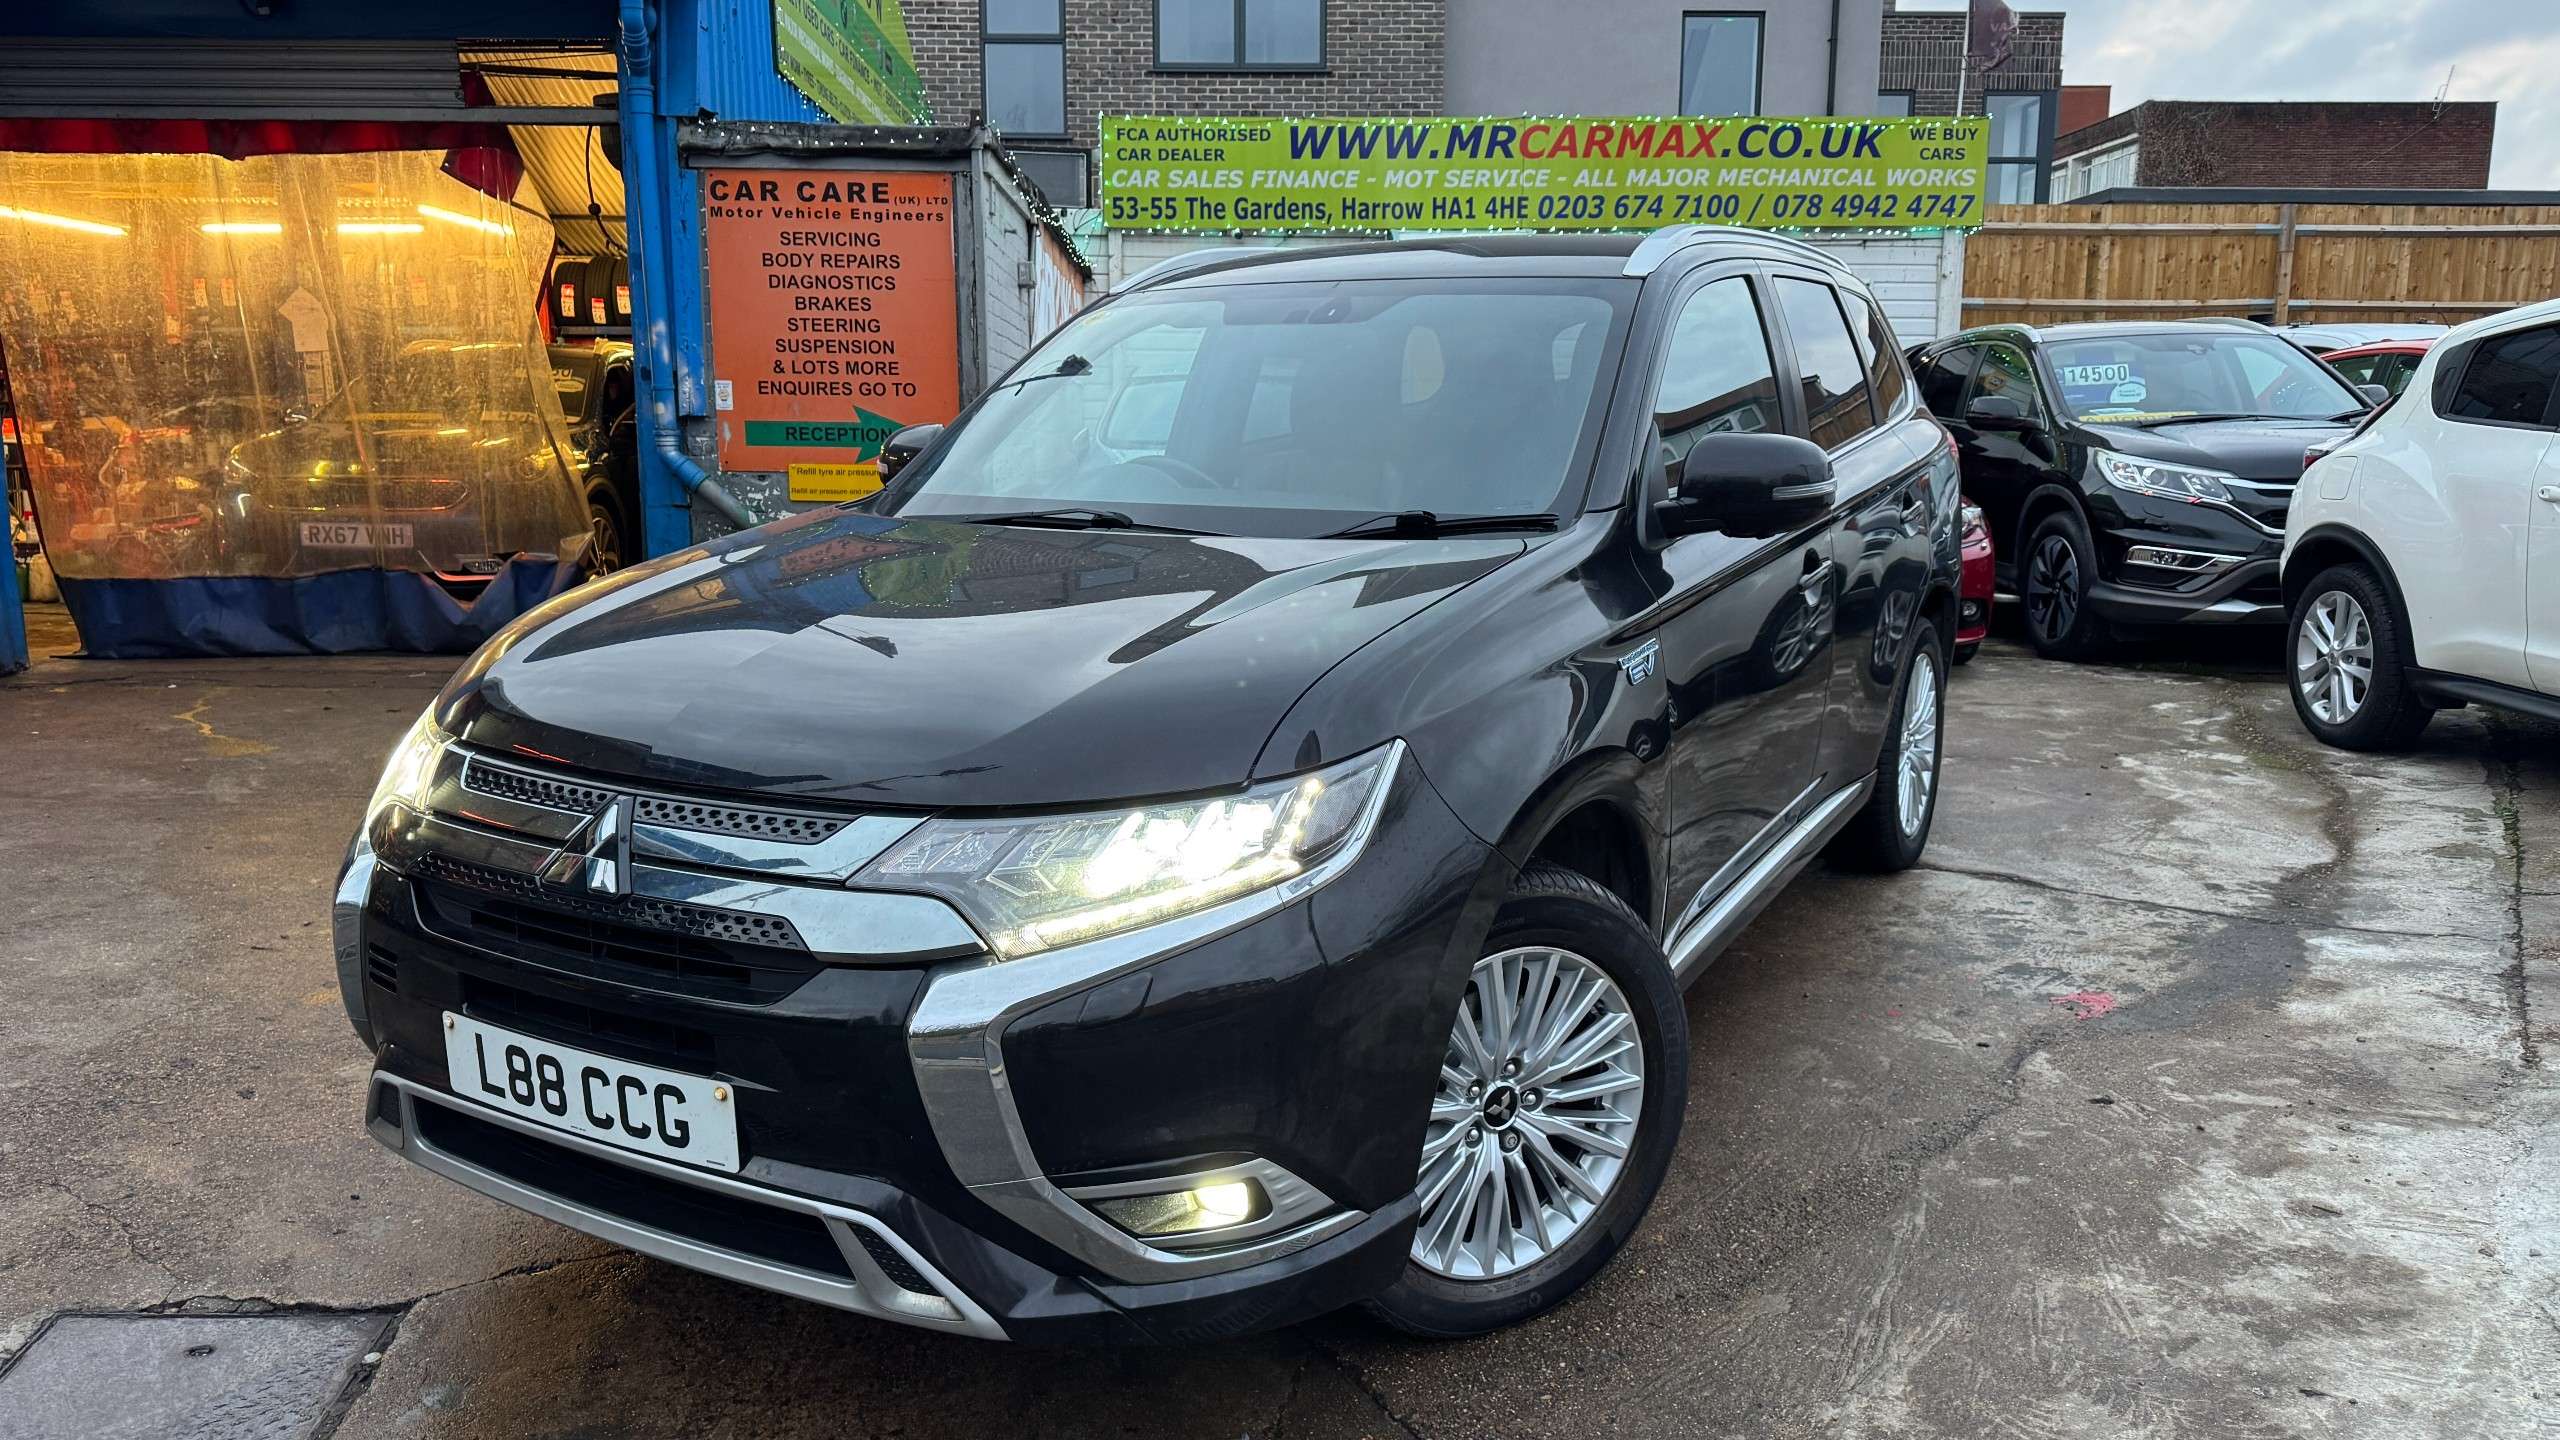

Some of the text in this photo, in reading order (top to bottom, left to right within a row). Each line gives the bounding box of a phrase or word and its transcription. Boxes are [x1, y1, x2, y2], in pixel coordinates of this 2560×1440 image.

[1116, 127, 1271, 142] FCA AUTHORISED
[1289, 124, 1889, 160] WWW.MRCARMAX.CO.UK
[1911, 127, 1978, 141] WE BUY
[1116, 148, 1225, 162] CAR DEALER
[1919, 147, 1966, 161] CARS
[1112, 169, 1160, 188] CAR
[1168, 169, 1244, 189] SALES
[1251, 169, 1360, 189] FINANCE
[1384, 169, 1439, 189] MOT
[1445, 168, 1551, 188] SERVICE
[1574, 168, 1617, 187] ALL
[1627, 168, 1710, 187] MAJOR
[1718, 167, 1876, 187] MECHANICAL
[1886, 168, 1977, 187] WORKS
[709, 179, 949, 207] CAR CARE (UK) LTD
[709, 203, 945, 224] Motor Vehicle Engineers
[1112, 196, 1178, 221] 53-55
[1185, 196, 1227, 220] The
[1234, 196, 1332, 225] Gardens,
[1341, 198, 1425, 221] Harrow
[1432, 197, 1475, 220] HA1
[1485, 196, 1528, 220] 4HE
[1538, 194, 1605, 219] 0203
[1613, 194, 1663, 219] 674
[1674, 194, 1741, 219] 7100
[1772, 194, 1825, 219] 078
[1831, 193, 1899, 218] 4942
[1906, 193, 1977, 219] 4747
[779, 231, 881, 248] SERVICING
[762, 253, 901, 270] BODY REPAIRS
[768, 274, 896, 291] DIAGNOSTICS
[794, 296, 872, 312] BRAKES
[787, 317, 881, 334] STEERING
[775, 338, 895, 355] SUSPENSION
[772, 359, 900, 376] & LOTS MORE
[757, 380, 917, 398] ENQUIRES GO TO
[784, 426, 892, 443] RECEPTION
[847, 469, 881, 478] pressur
[307, 525, 359, 543] RX67
[475, 1032, 691, 1149] L88 CCG
